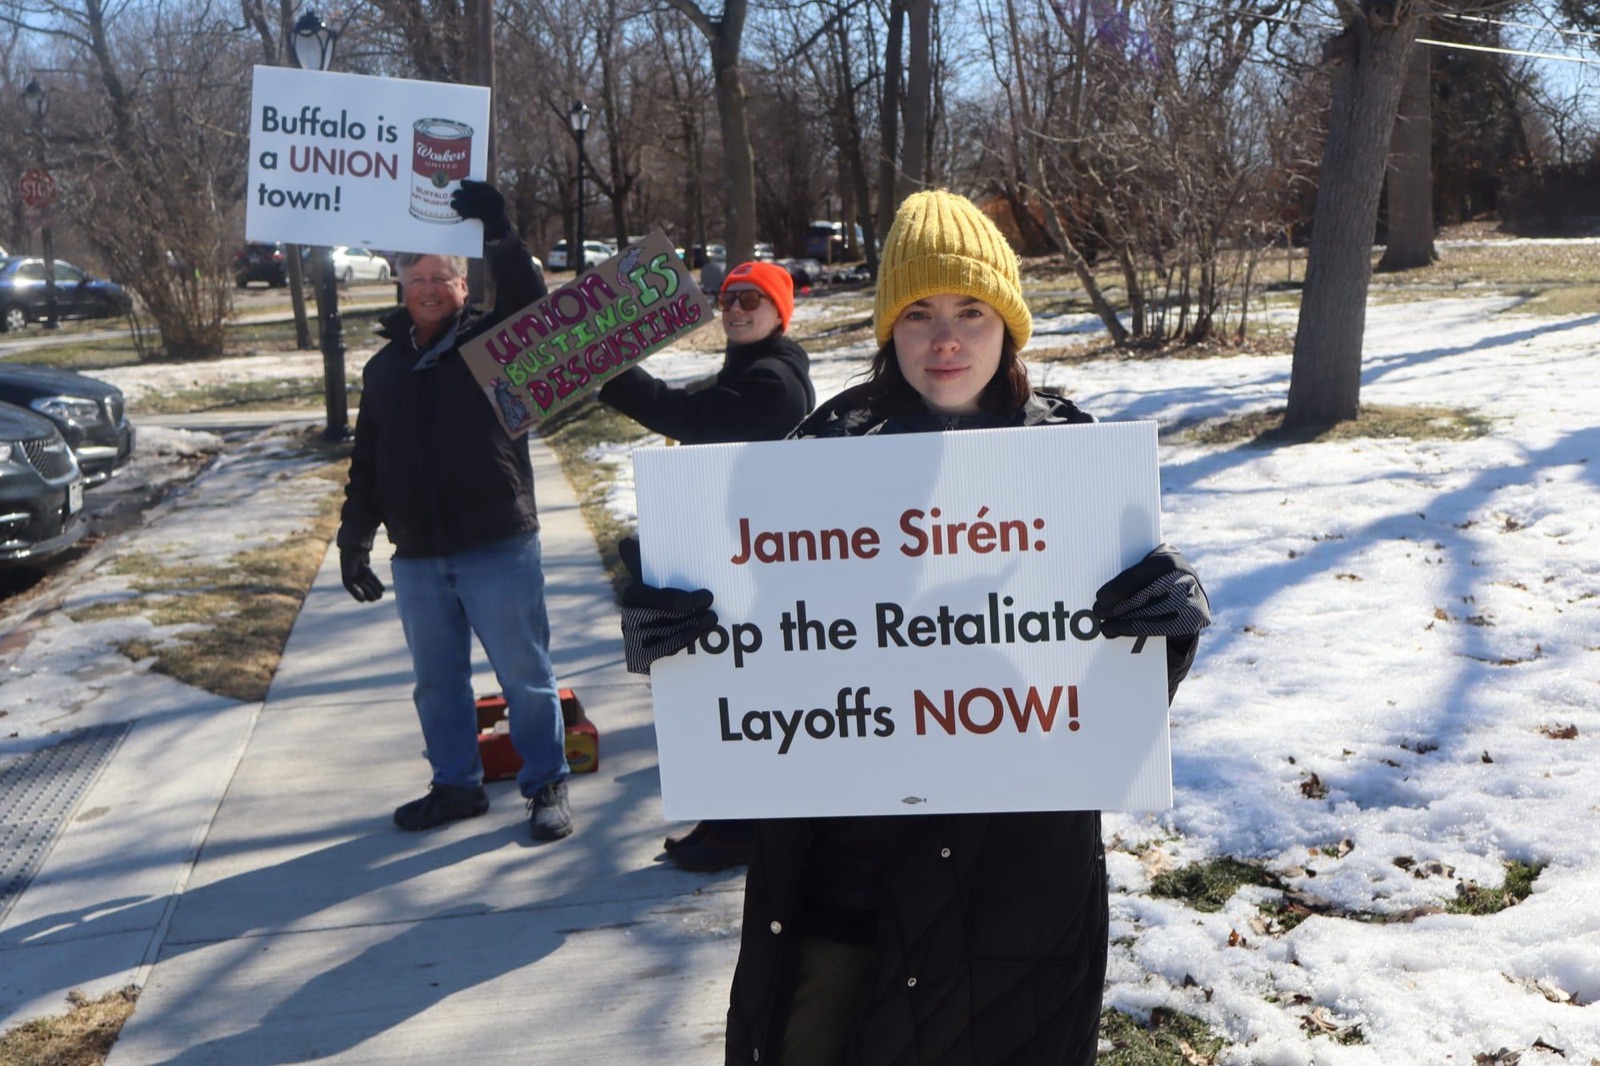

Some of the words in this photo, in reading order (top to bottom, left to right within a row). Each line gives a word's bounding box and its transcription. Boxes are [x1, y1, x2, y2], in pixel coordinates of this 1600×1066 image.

[262, 105, 366, 141] Buffalo
[377, 115, 398, 143] is
[259, 151, 278, 170] a
[290, 145, 398, 180] UNION
[416, 142, 467, 162] Workers
[258, 183, 341, 213] town!
[416, 186, 448, 199] BUFFALO
[504, 295, 640, 387] BUSTING
[628, 253, 679, 307] IS
[527, 294, 700, 410] DISGUSTING
[730, 518, 881, 565] Janne
[900, 506, 1047, 558] Sirén:
[686, 622, 763, 668] op
[780, 600, 858, 652] the
[875, 592, 1149, 654] Retaliato
[718, 686, 895, 754] Layoffs
[913, 685, 1081, 736] NOW!
